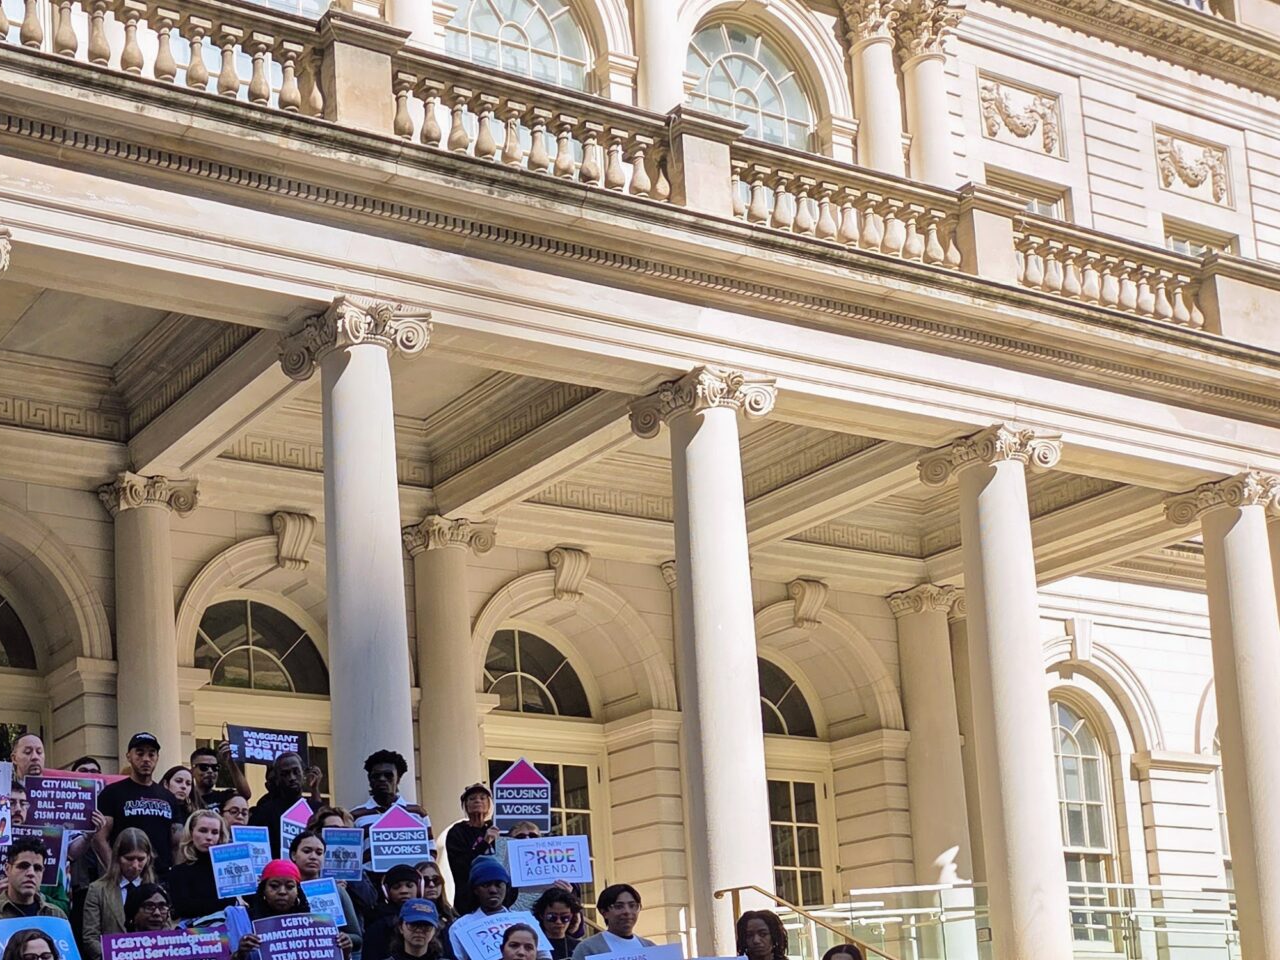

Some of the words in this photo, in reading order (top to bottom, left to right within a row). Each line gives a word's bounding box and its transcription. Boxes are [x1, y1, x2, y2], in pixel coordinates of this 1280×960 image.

[243, 731, 299, 743] IMMIGRANT
[244, 739, 299, 752] JUSTICE
[245, 746, 273, 761] FOR
[41, 780, 60, 788] CITY
[30, 790, 55, 798] DON'T
[56, 791, 77, 800] DROP
[78, 792, 92, 800] THE
[497, 789, 547, 799] HOUSING
[37, 801, 55, 809] BALL
[64, 802, 85, 810] FUND
[501, 805, 542, 814] WORKS
[55, 811, 71, 819] FOR
[373, 832, 424, 841] HOUSING
[379, 845, 422, 854] WORKS
[524, 848, 576, 867] PRIDE
[526, 865, 577, 877] AGENDA
[280, 916, 314, 927] LGBTQ+
[111, 936, 156, 949] LGBTQ+
[157, 930, 221, 943] Immigrant
[257, 928, 315, 942] IMMIGRANT
[315, 926, 337, 936] LIVES
[269, 941, 288, 952] ARE
[289, 940, 307, 950] NOT
[308, 940, 315, 948] A
[315, 938, 333, 947] LINE
[145, 945, 192, 959] Services
[192, 943, 222, 955] Fund
[297, 951, 310, 960] TO
[310, 949, 334, 959] DELAY
